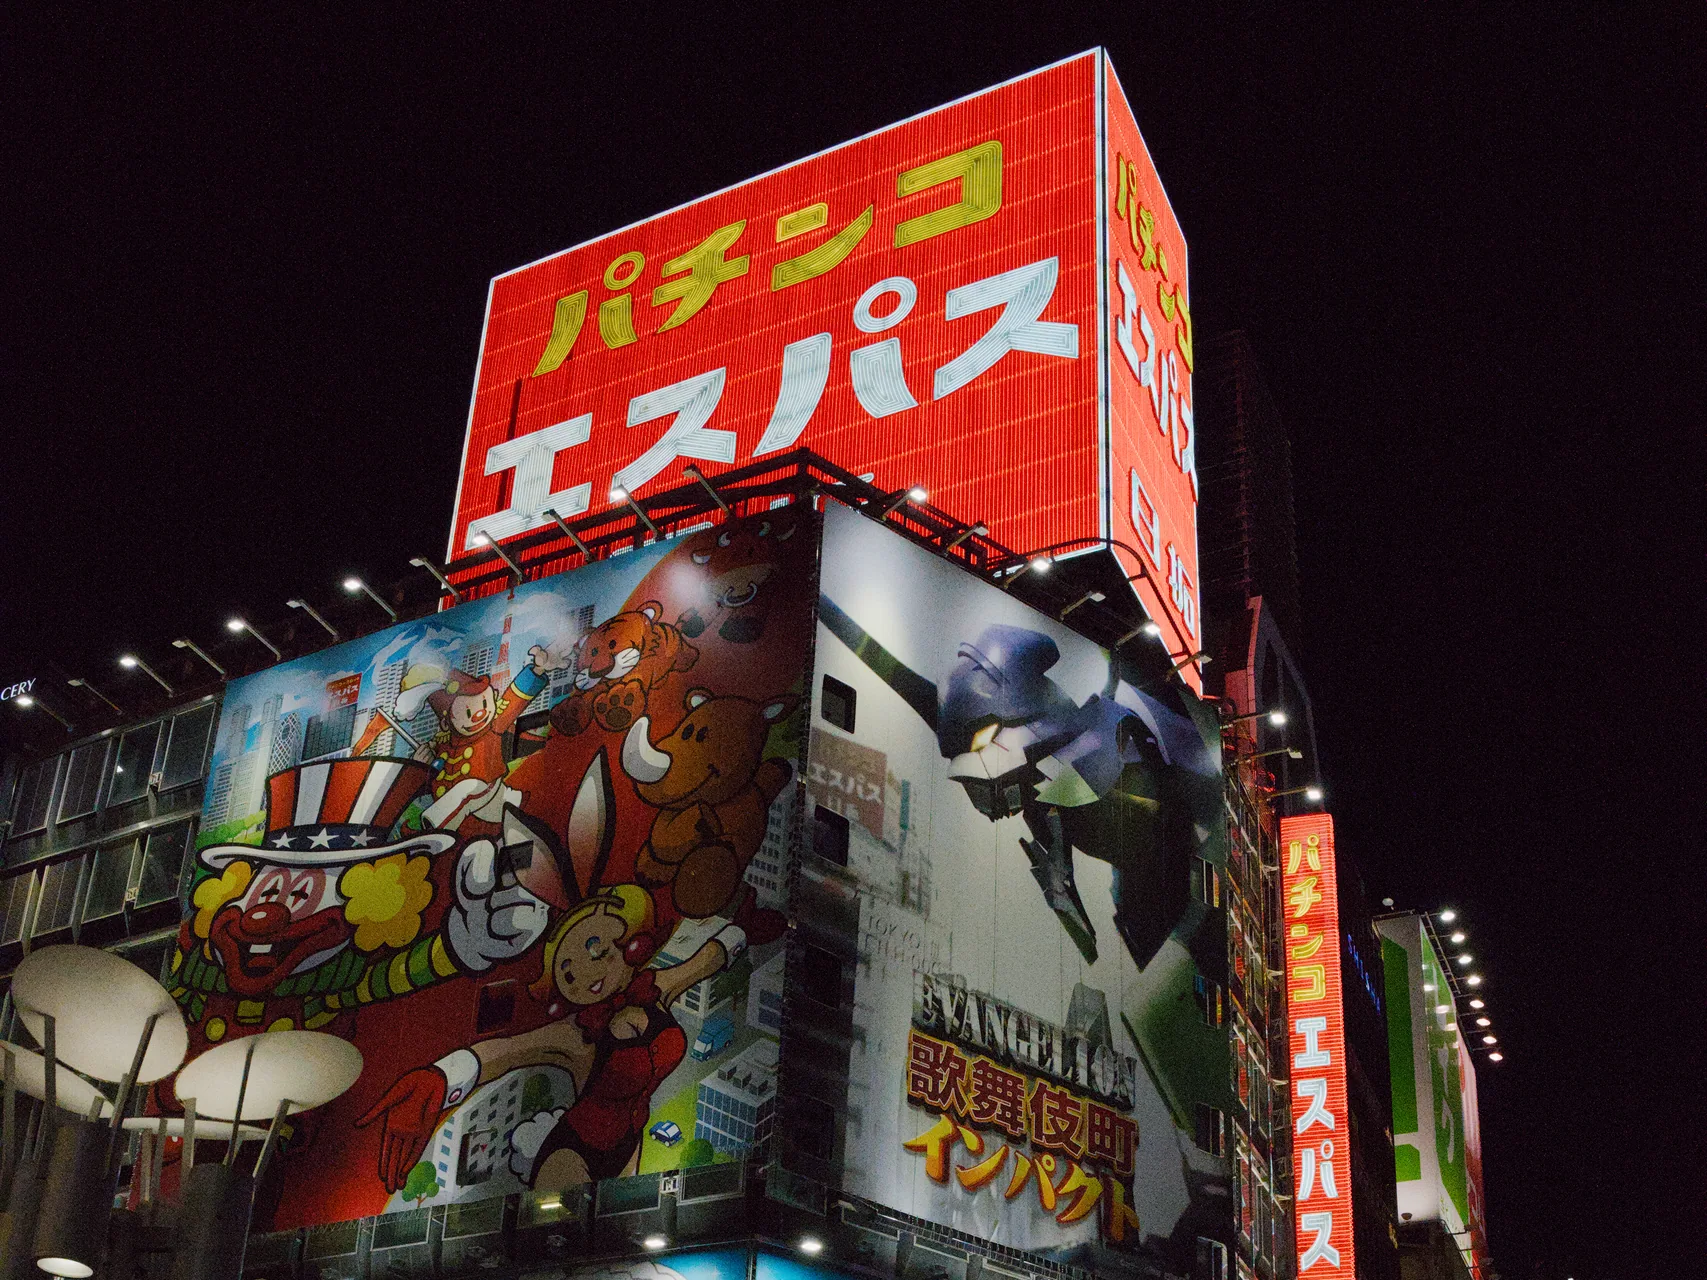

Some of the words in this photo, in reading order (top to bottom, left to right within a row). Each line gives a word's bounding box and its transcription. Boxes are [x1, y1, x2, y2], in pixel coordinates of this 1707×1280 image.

[533, 140, 1003, 378] パチンコ
[1115, 151, 1194, 375] パチンコ
[465, 255, 1079, 551] エスパス
[1116, 258, 1199, 506] エスパス
[1, 677, 37, 701] CERY
[1286, 834, 1326, 1002] パチンコ
[907, 1027, 1140, 1177] 歌舞伎町
[912, 970, 1138, 1106] EVANGELION
[903, 1112, 1141, 1242] インパクト
[1294, 1016, 1341, 1272] エスパス
